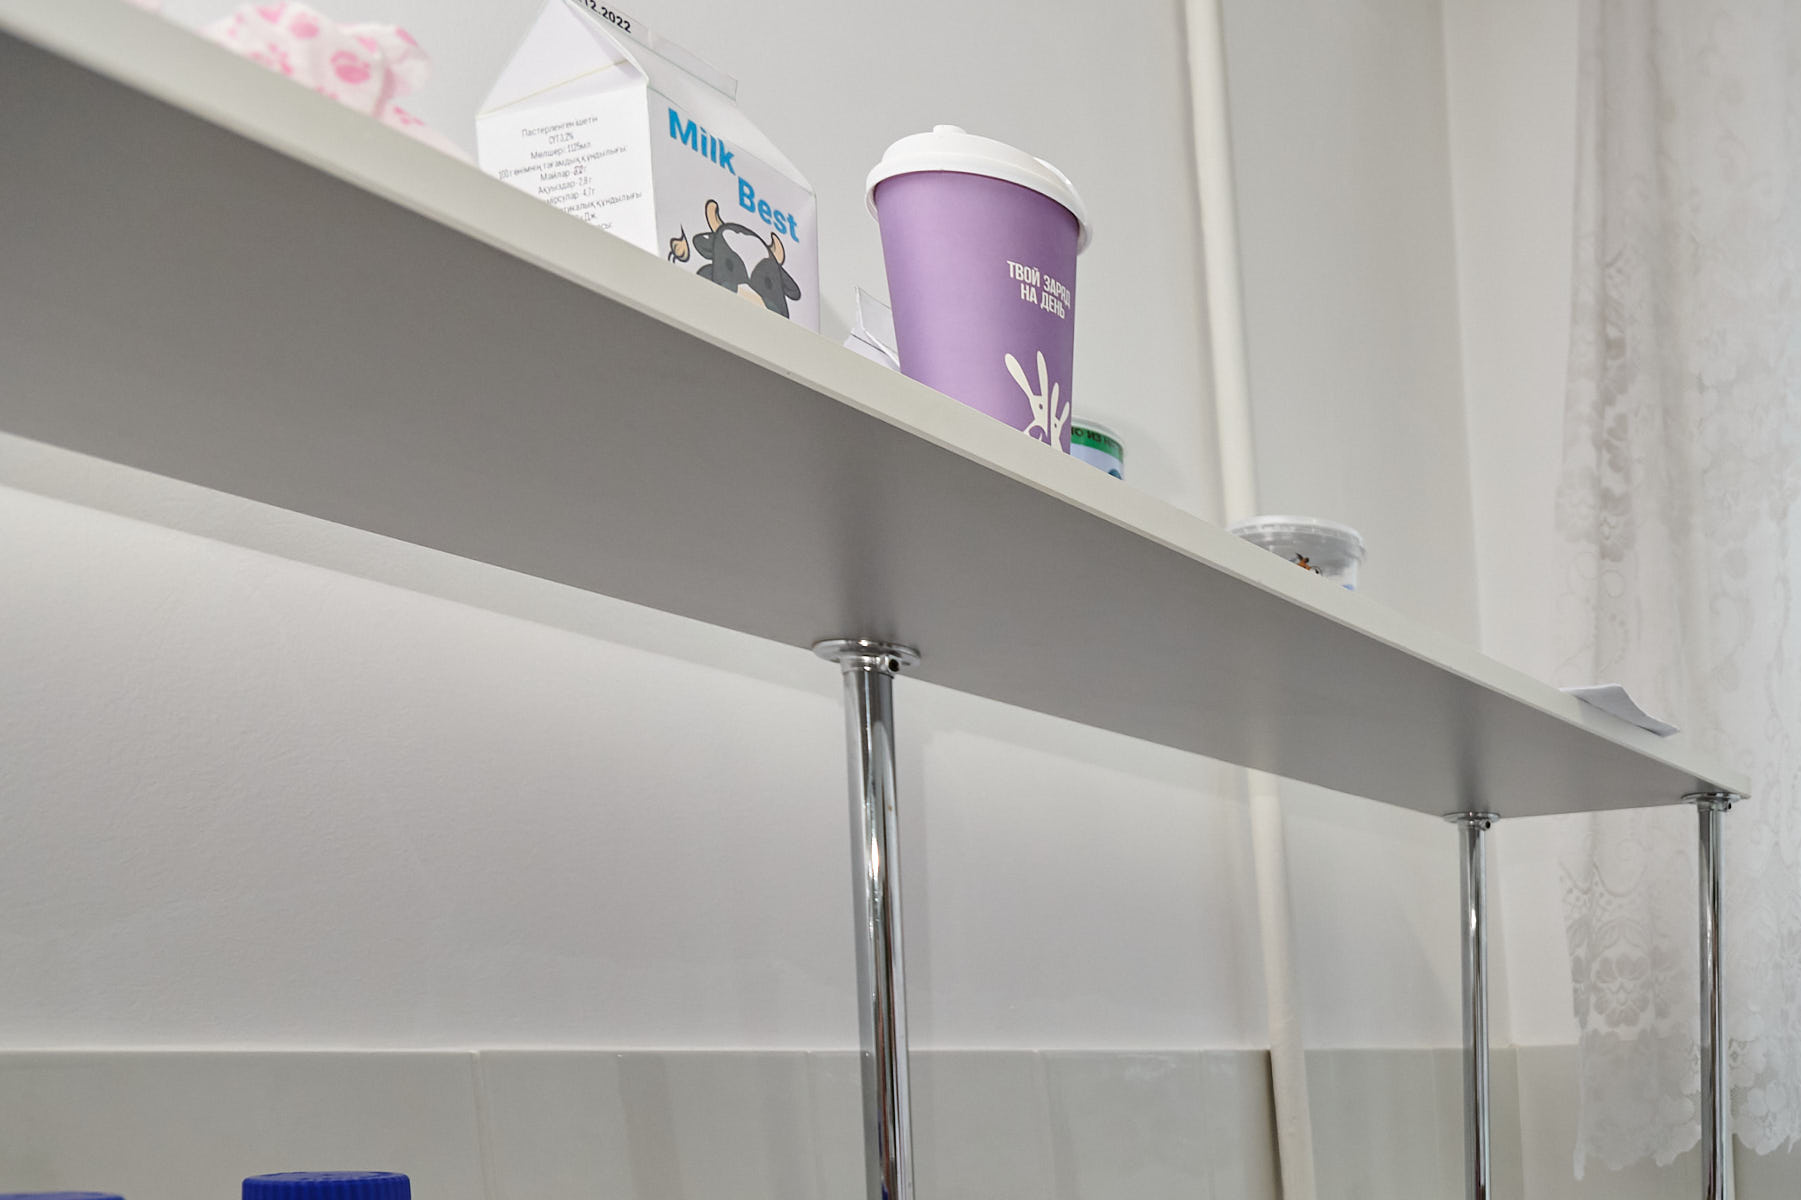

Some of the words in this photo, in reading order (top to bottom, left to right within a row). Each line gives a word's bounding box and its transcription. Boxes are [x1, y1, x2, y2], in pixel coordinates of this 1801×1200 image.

[667, 107, 736, 176] Milk
[737, 175, 800, 243] Best
[1006, 260, 1040, 288] ТВОЙ
[1043, 274, 1071, 310] ЗАРЯД
[1020, 283, 1038, 305] НА
[1040, 291, 1066, 320] ДЕНЬ
